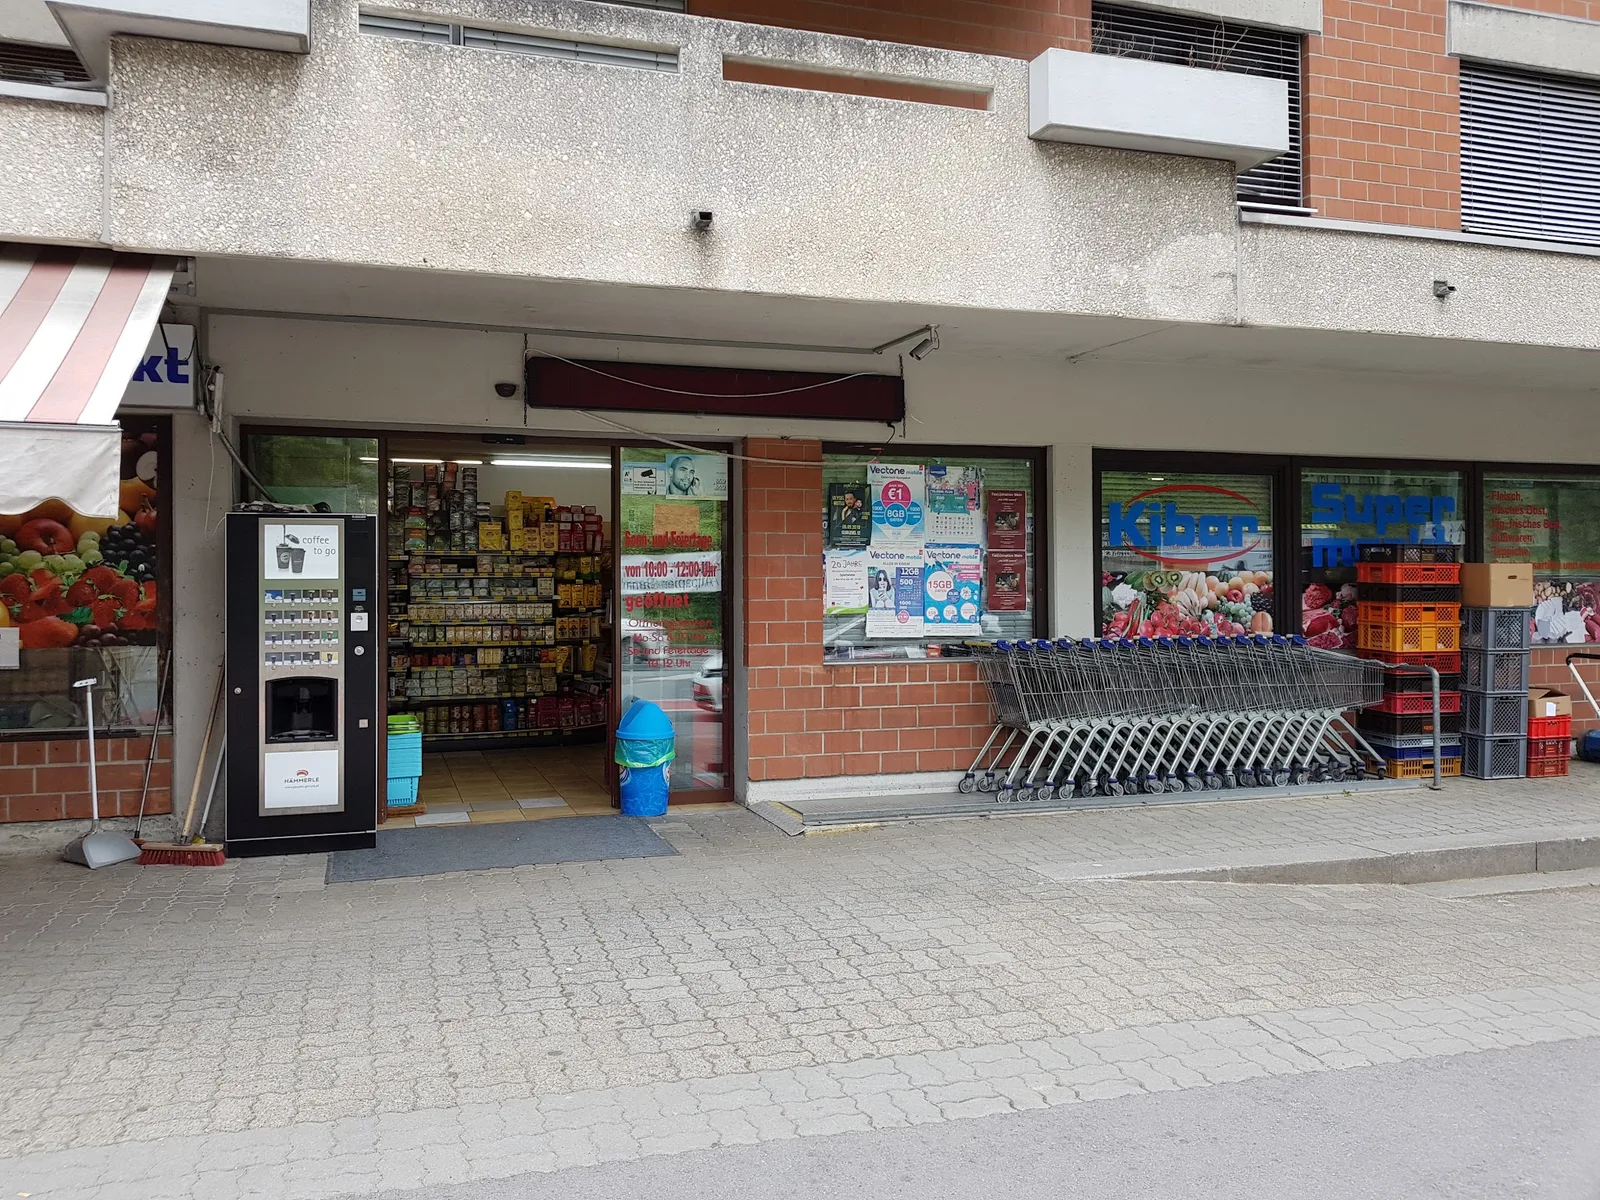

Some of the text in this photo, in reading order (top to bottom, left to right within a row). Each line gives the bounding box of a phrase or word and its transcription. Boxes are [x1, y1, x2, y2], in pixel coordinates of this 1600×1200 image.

[870, 465, 905, 475] Vectone
[888, 488, 903, 500] €1
[887, 509, 905, 518] 8GB
[1312, 483, 1455, 535] Super
[1109, 502, 1258, 547] Kibar
[302, 535, 330, 545] coffee
[652, 531, 669, 547] und
[670, 531, 713, 552] Feiertage
[313, 547, 336, 557] to go
[870, 551, 905, 559] Vectone
[625, 565, 641, 577] von
[643, 561, 668, 577] 10:00
[676, 561, 699, 577] 12:00
[700, 561, 717, 577] Uhr
[831, 560, 842, 569] 20
[900, 567, 920, 576] 12GB
[928, 580, 952, 589] 15GB
[625, 592, 690, 612] geöffnet
